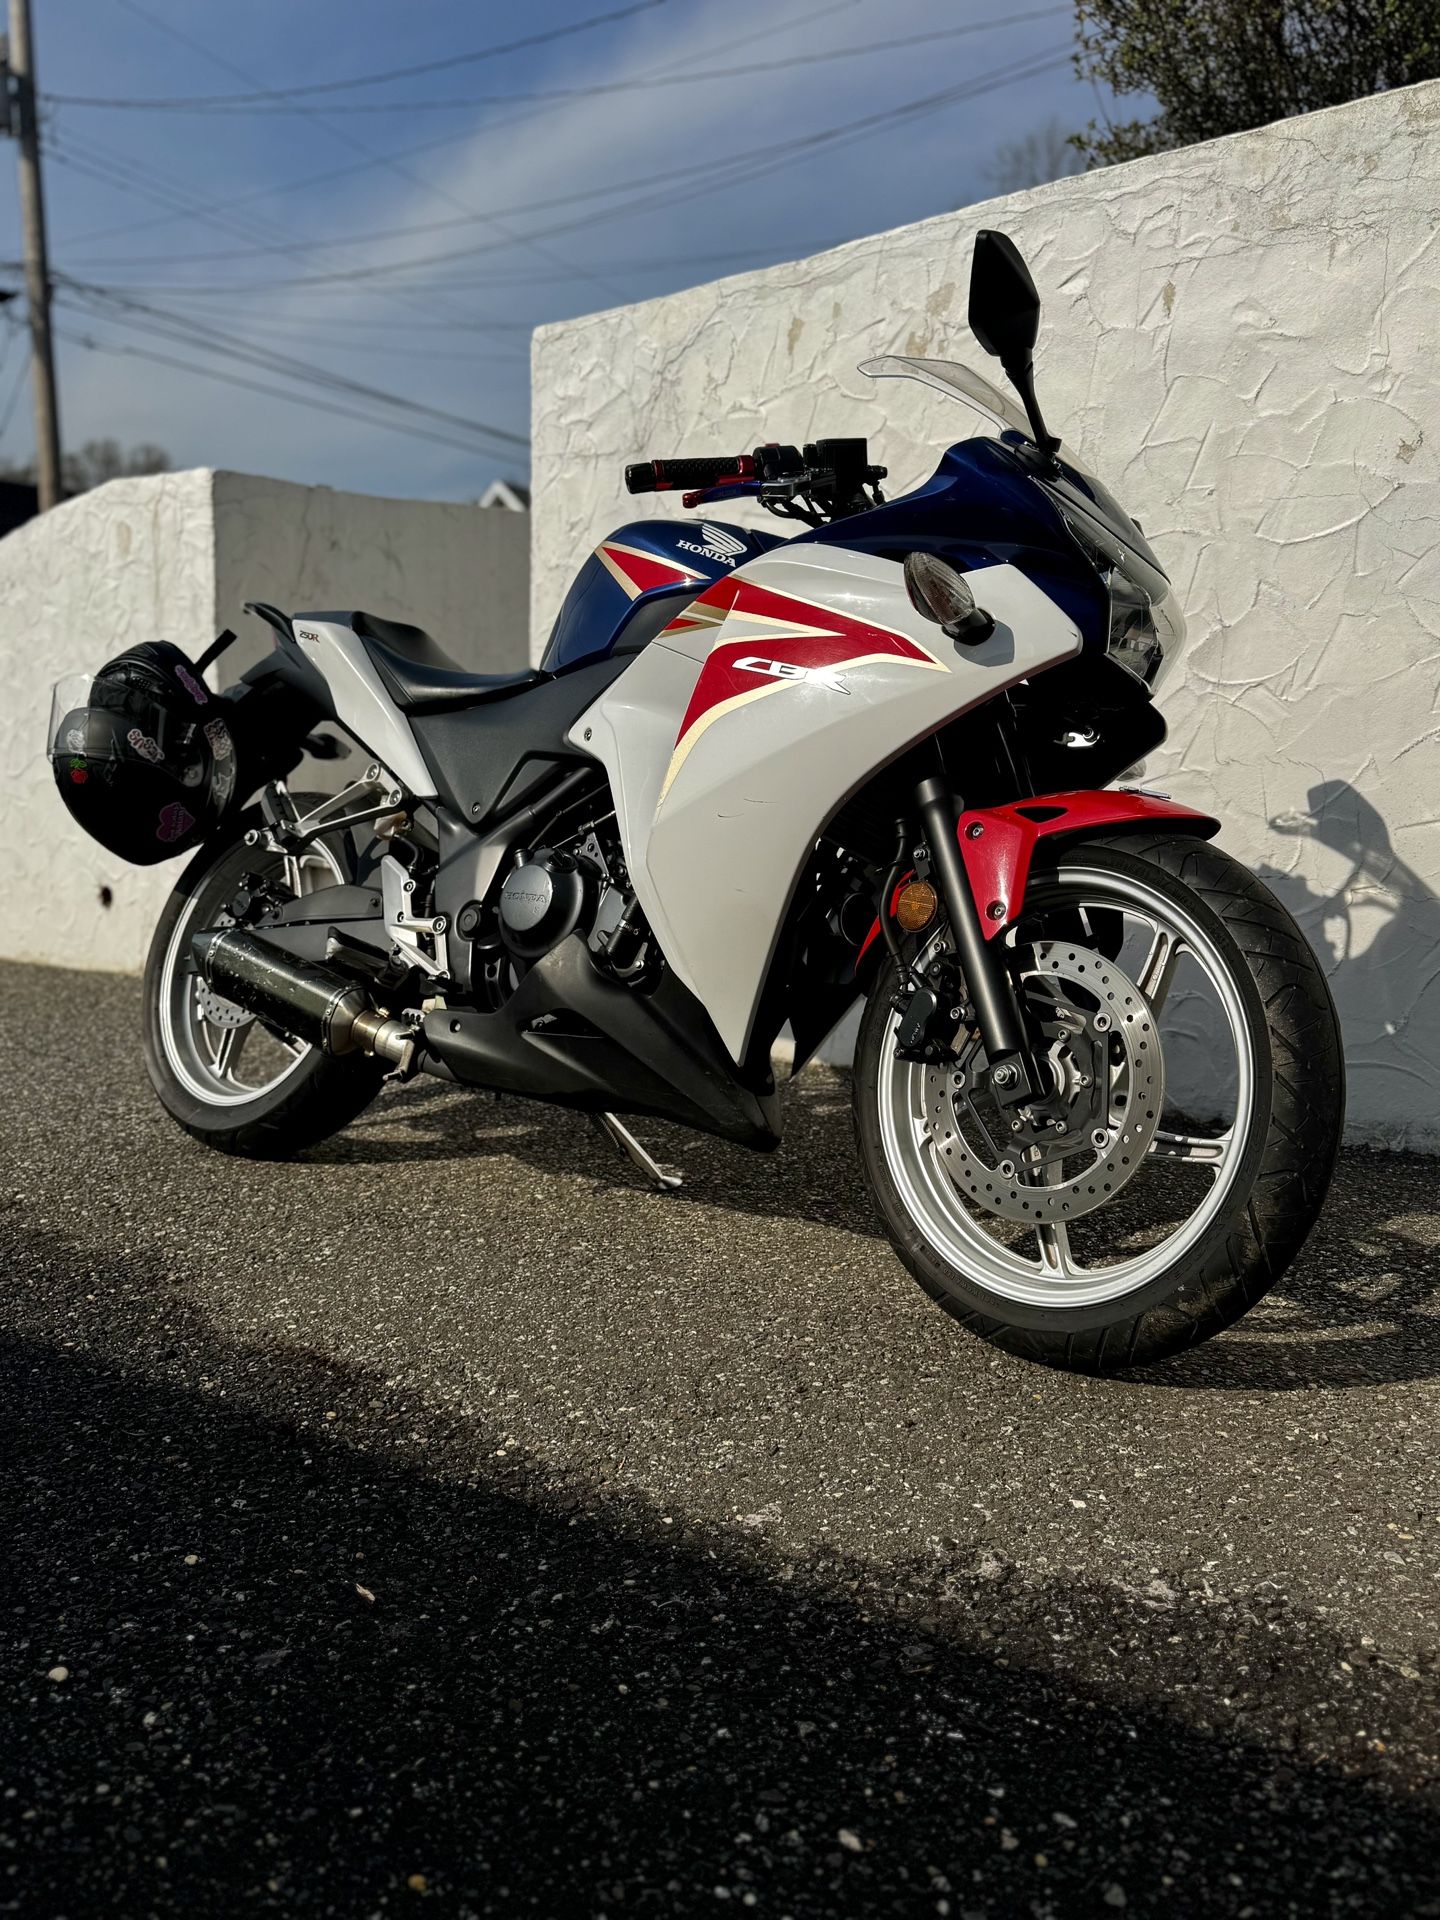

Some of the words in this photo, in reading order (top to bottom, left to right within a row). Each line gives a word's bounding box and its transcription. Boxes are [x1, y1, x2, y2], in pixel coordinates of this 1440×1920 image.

[676, 539, 736, 567] HONDA
[299, 630, 320, 643] 250R
[732, 656, 851, 695] CBR
[503, 891, 548, 903] HONDA
